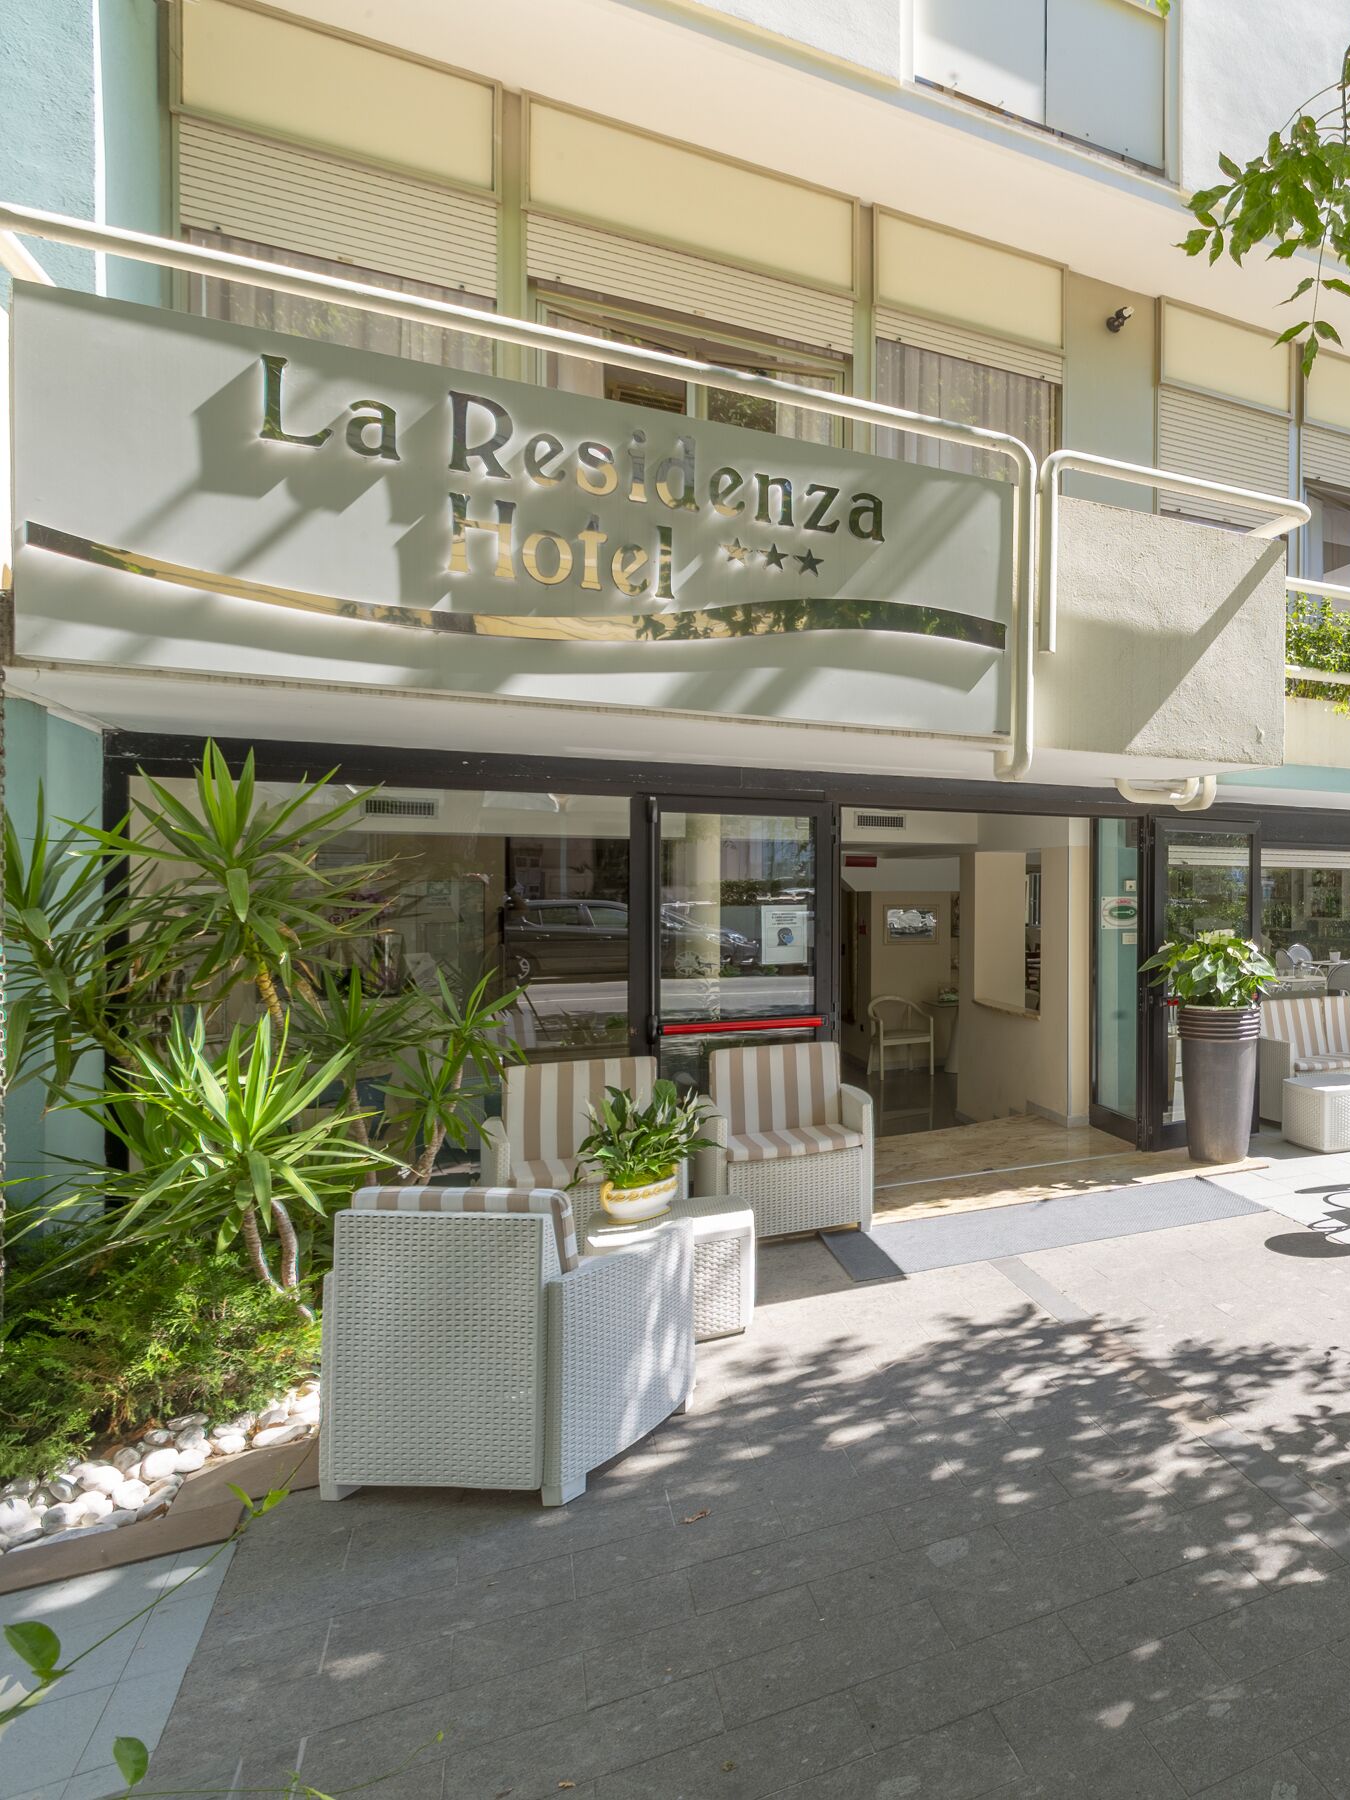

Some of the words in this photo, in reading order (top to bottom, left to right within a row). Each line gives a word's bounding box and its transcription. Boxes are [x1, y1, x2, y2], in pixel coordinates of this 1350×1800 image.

[259, 354, 401, 461] La
[448, 390, 886, 544] Residenza
[446, 491, 675, 600] Hotel
